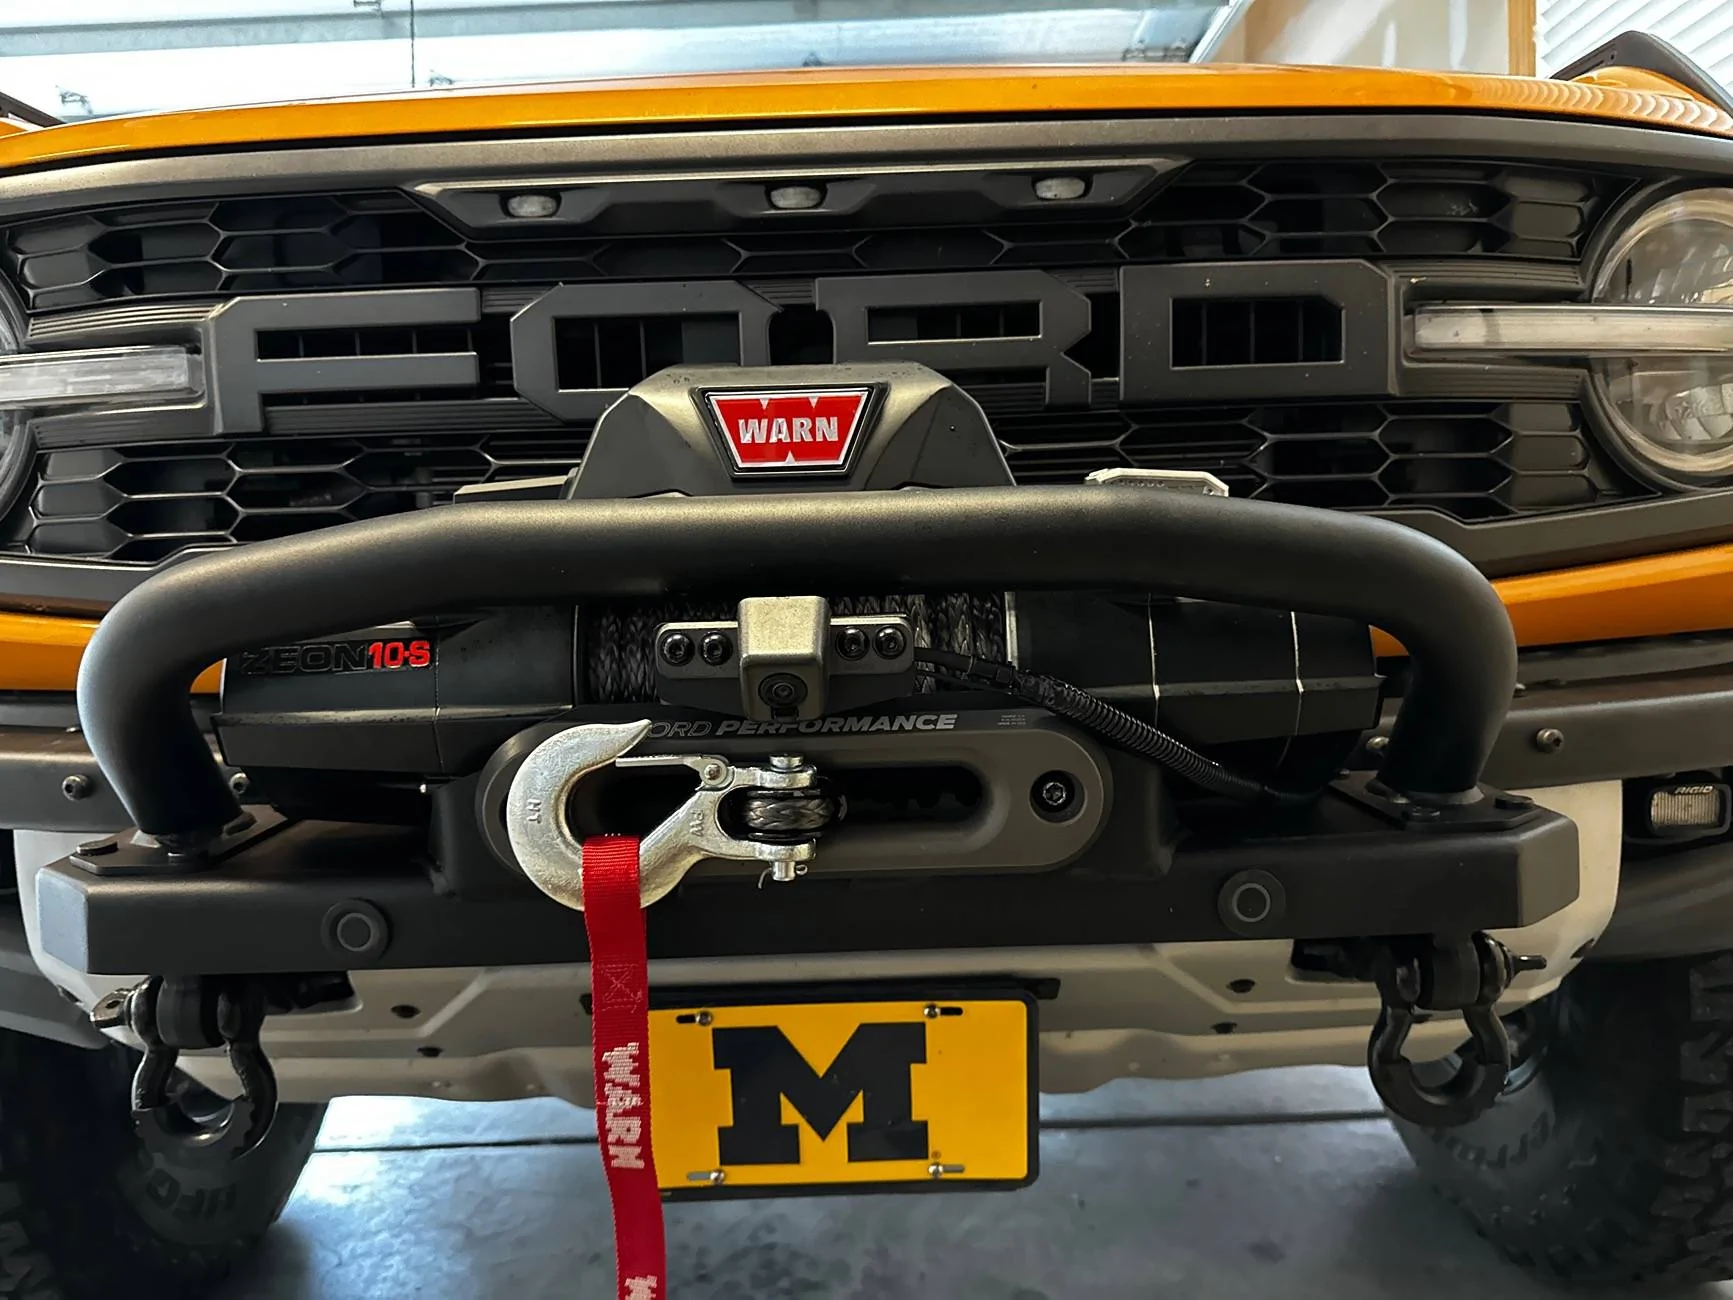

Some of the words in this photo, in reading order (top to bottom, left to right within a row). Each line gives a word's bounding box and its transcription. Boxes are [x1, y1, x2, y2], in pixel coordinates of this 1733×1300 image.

[207, 260, 1397, 436] FORD
[738, 416, 838, 444] WARN
[240, 642, 367, 675] ZEON
[650, 720, 712, 738] ORD
[715, 713, 958, 736] PERFORMANCE
[1674, 785, 1714, 794] RIGID
[602, 1042, 645, 1169] WARN
[712, 1022, 929, 1165] M
